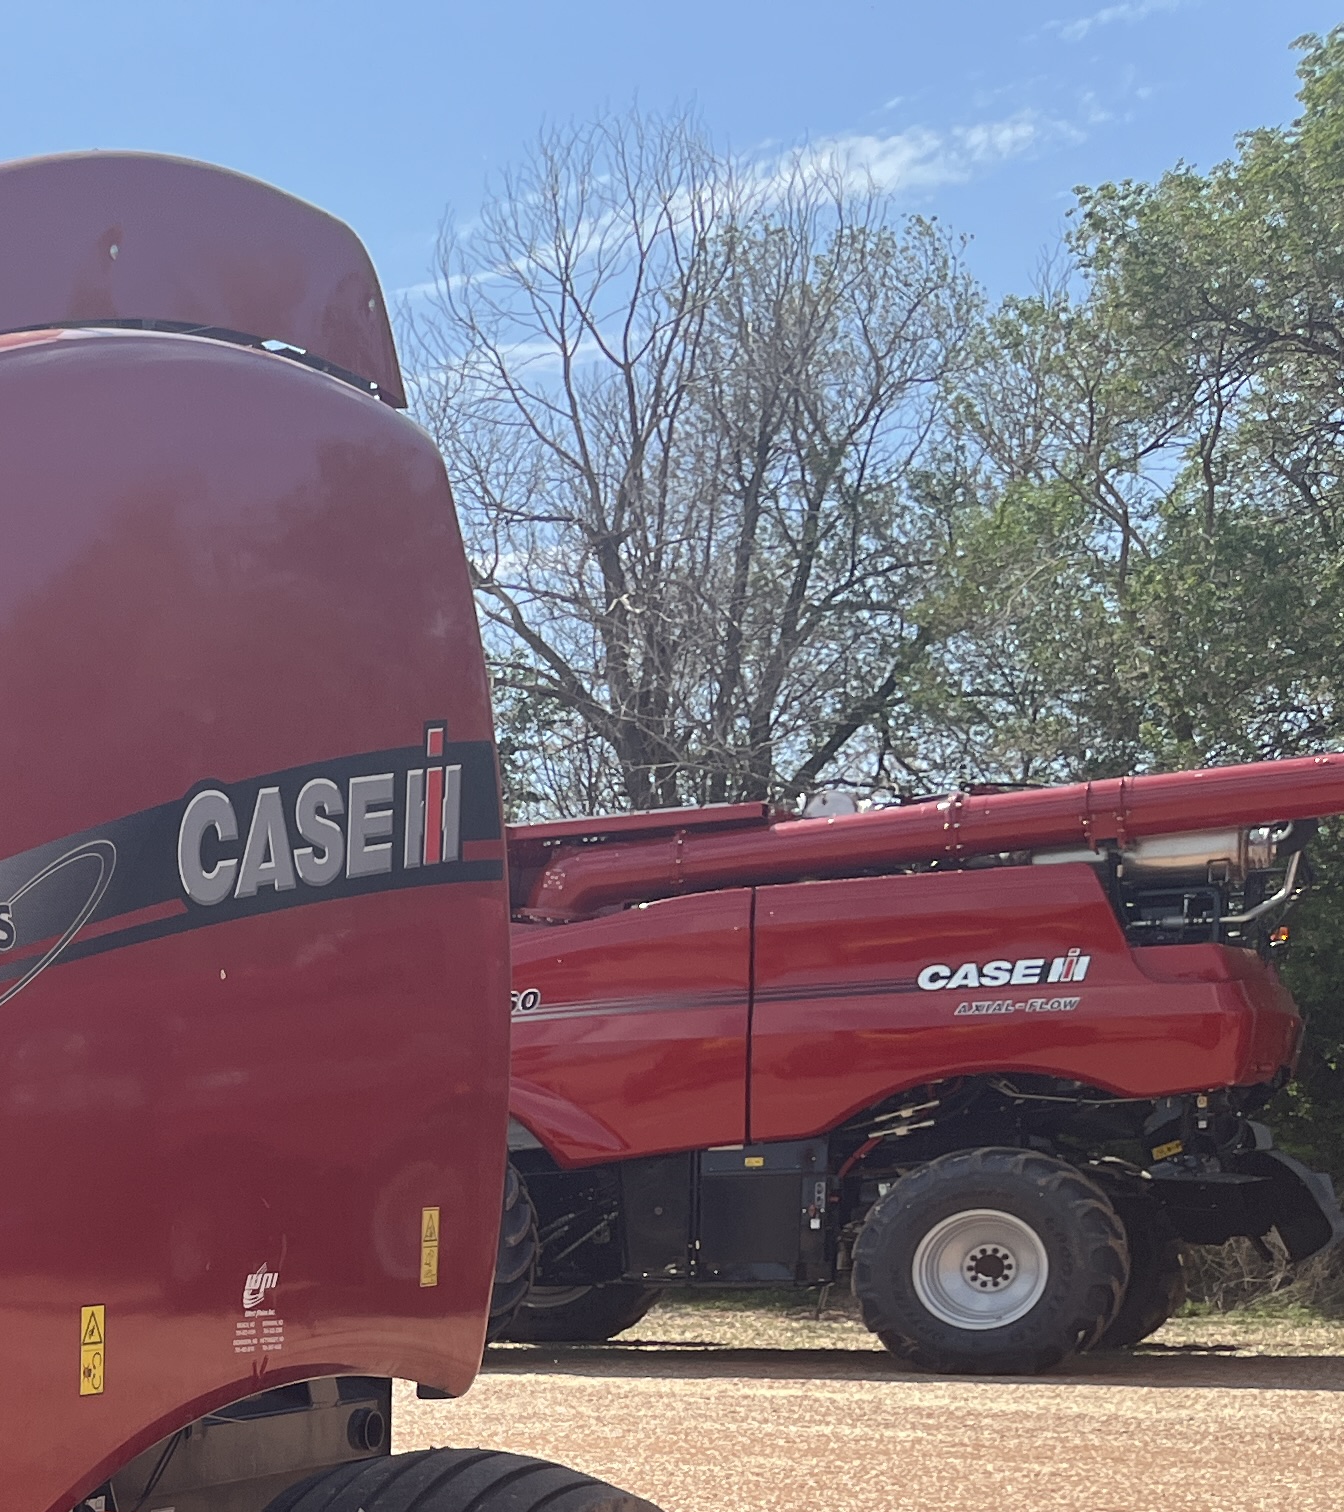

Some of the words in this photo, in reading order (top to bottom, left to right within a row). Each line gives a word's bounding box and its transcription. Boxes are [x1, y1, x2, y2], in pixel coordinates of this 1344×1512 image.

[177, 771, 395, 906] CASE
[917, 958, 1045, 991] CASE
[954, 997, 1081, 1016] AXIAL-FLOW
